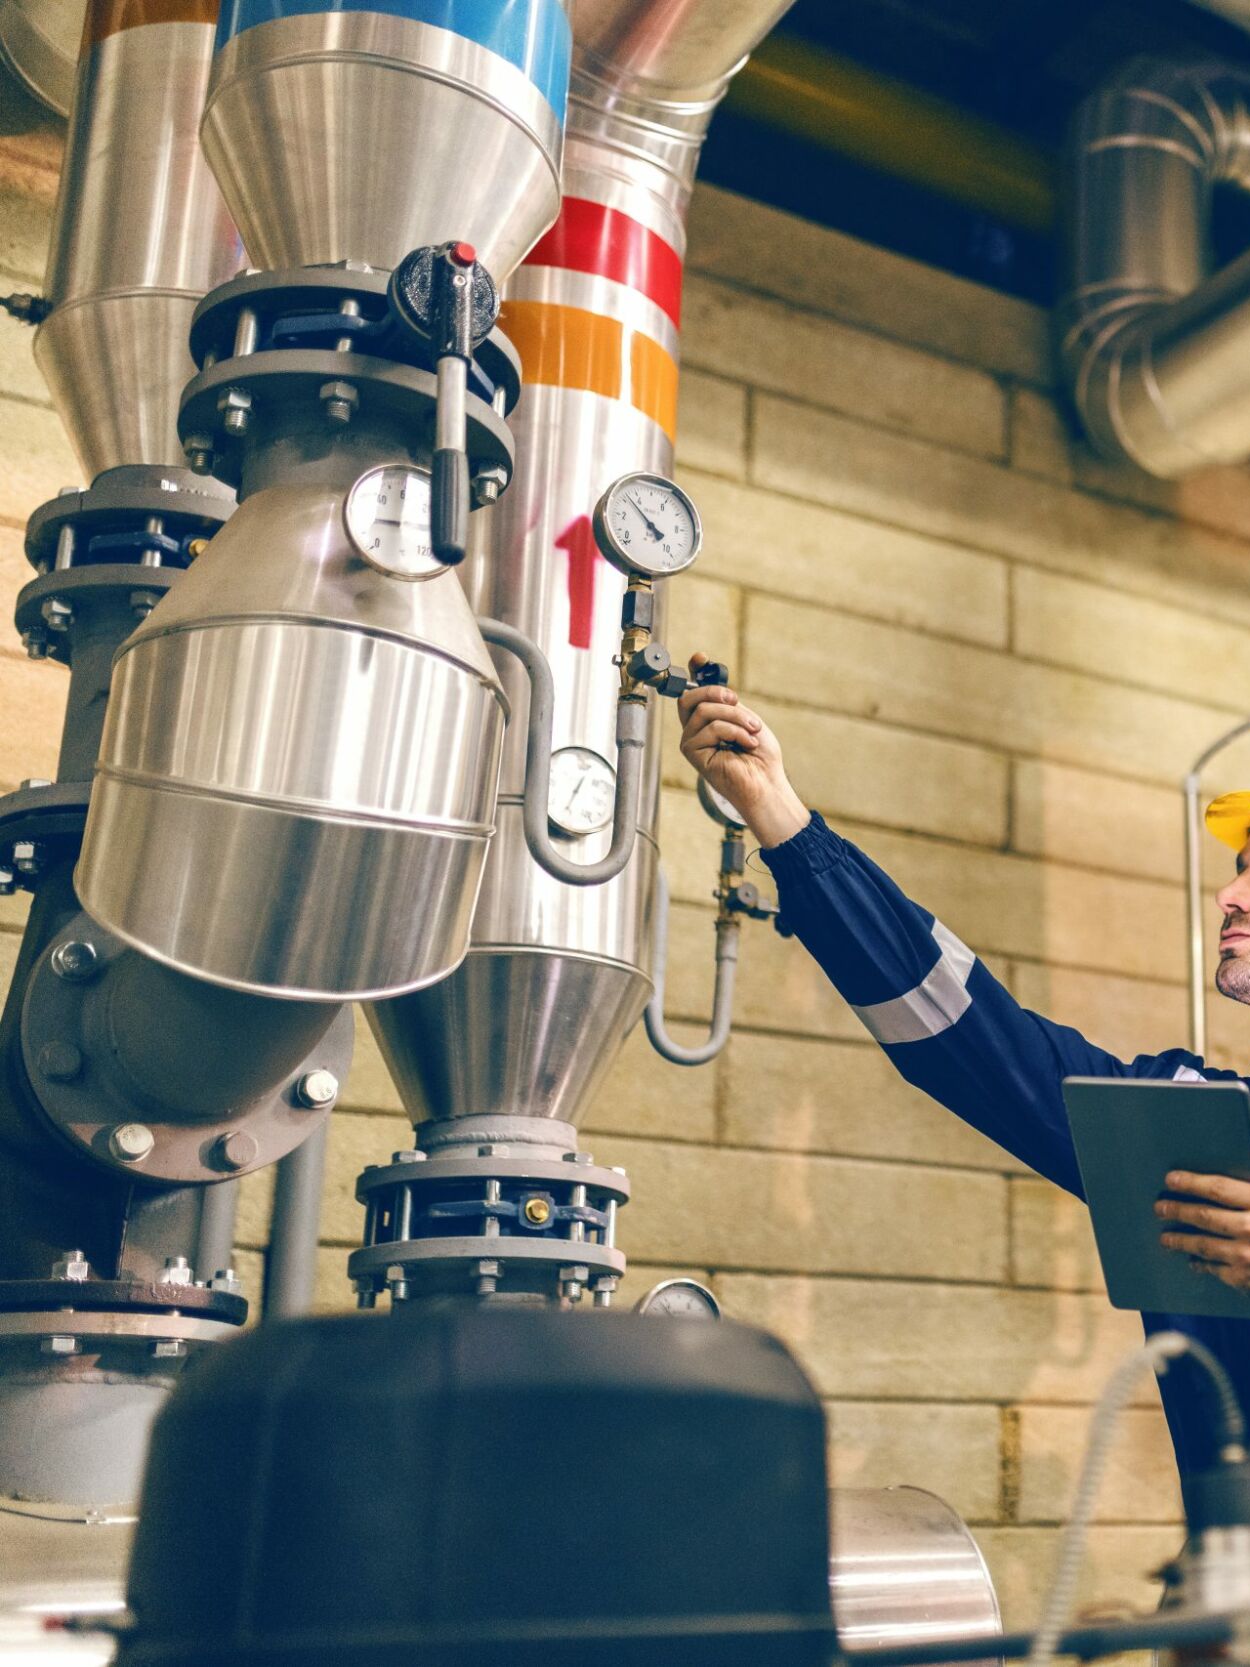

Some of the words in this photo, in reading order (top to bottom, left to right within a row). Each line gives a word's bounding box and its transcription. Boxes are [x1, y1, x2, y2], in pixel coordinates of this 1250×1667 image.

[621, 511, 627, 521] 2
[624, 530, 630, 539] 0
[374, 537, 380, 548] 0
[662, 543, 671, 553] 10
